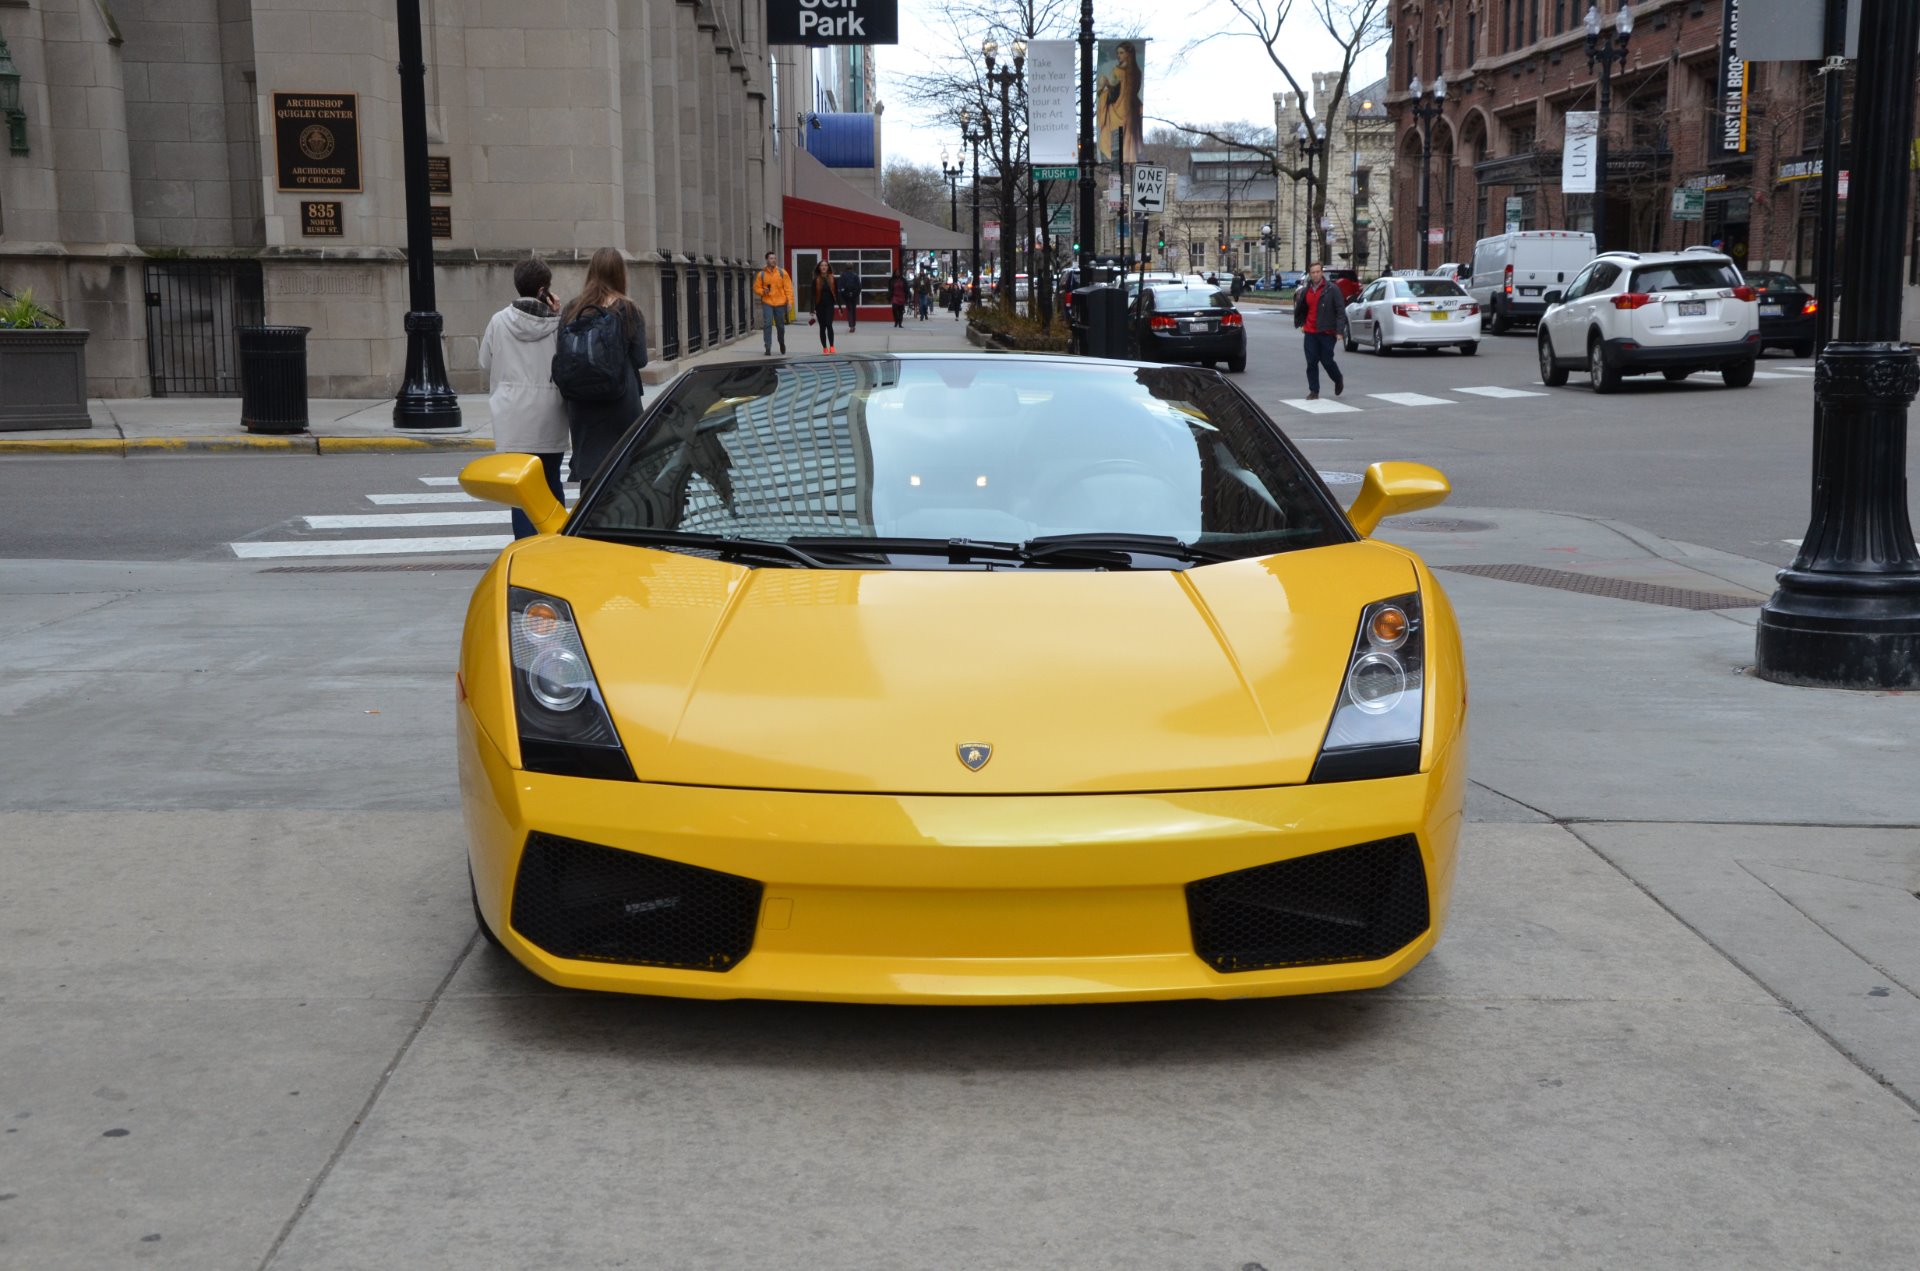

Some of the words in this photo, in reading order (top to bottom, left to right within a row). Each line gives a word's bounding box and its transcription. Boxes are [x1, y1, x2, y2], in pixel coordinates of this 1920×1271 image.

[799, 11, 866, 36] Park
[1032, 59, 1052, 68] Take
[1032, 72, 1046, 80] the
[1048, 71, 1067, 80] Year
[1031, 84, 1041, 94] of
[1043, 84, 1070, 95] Mercy
[286, 99, 344, 108] ARCHBISHOP
[277, 110, 318, 119] QUIGLEY
[318, 110, 353, 119] CENTER
[1032, 110, 1047, 119] the
[1049, 110, 1063, 119] Art
[1723, 91, 1742, 150] EINSTEIN
[1033, 122, 1070, 132] Institute
[292, 167, 346, 175] ARCHDIOCESE
[1041, 169, 1066, 178] RUSH
[1138, 170, 1163, 182] ONE
[1137, 182, 1163, 194] WAY
[308, 203, 335, 218] 835
[1443, 299, 1458, 307] 5017
